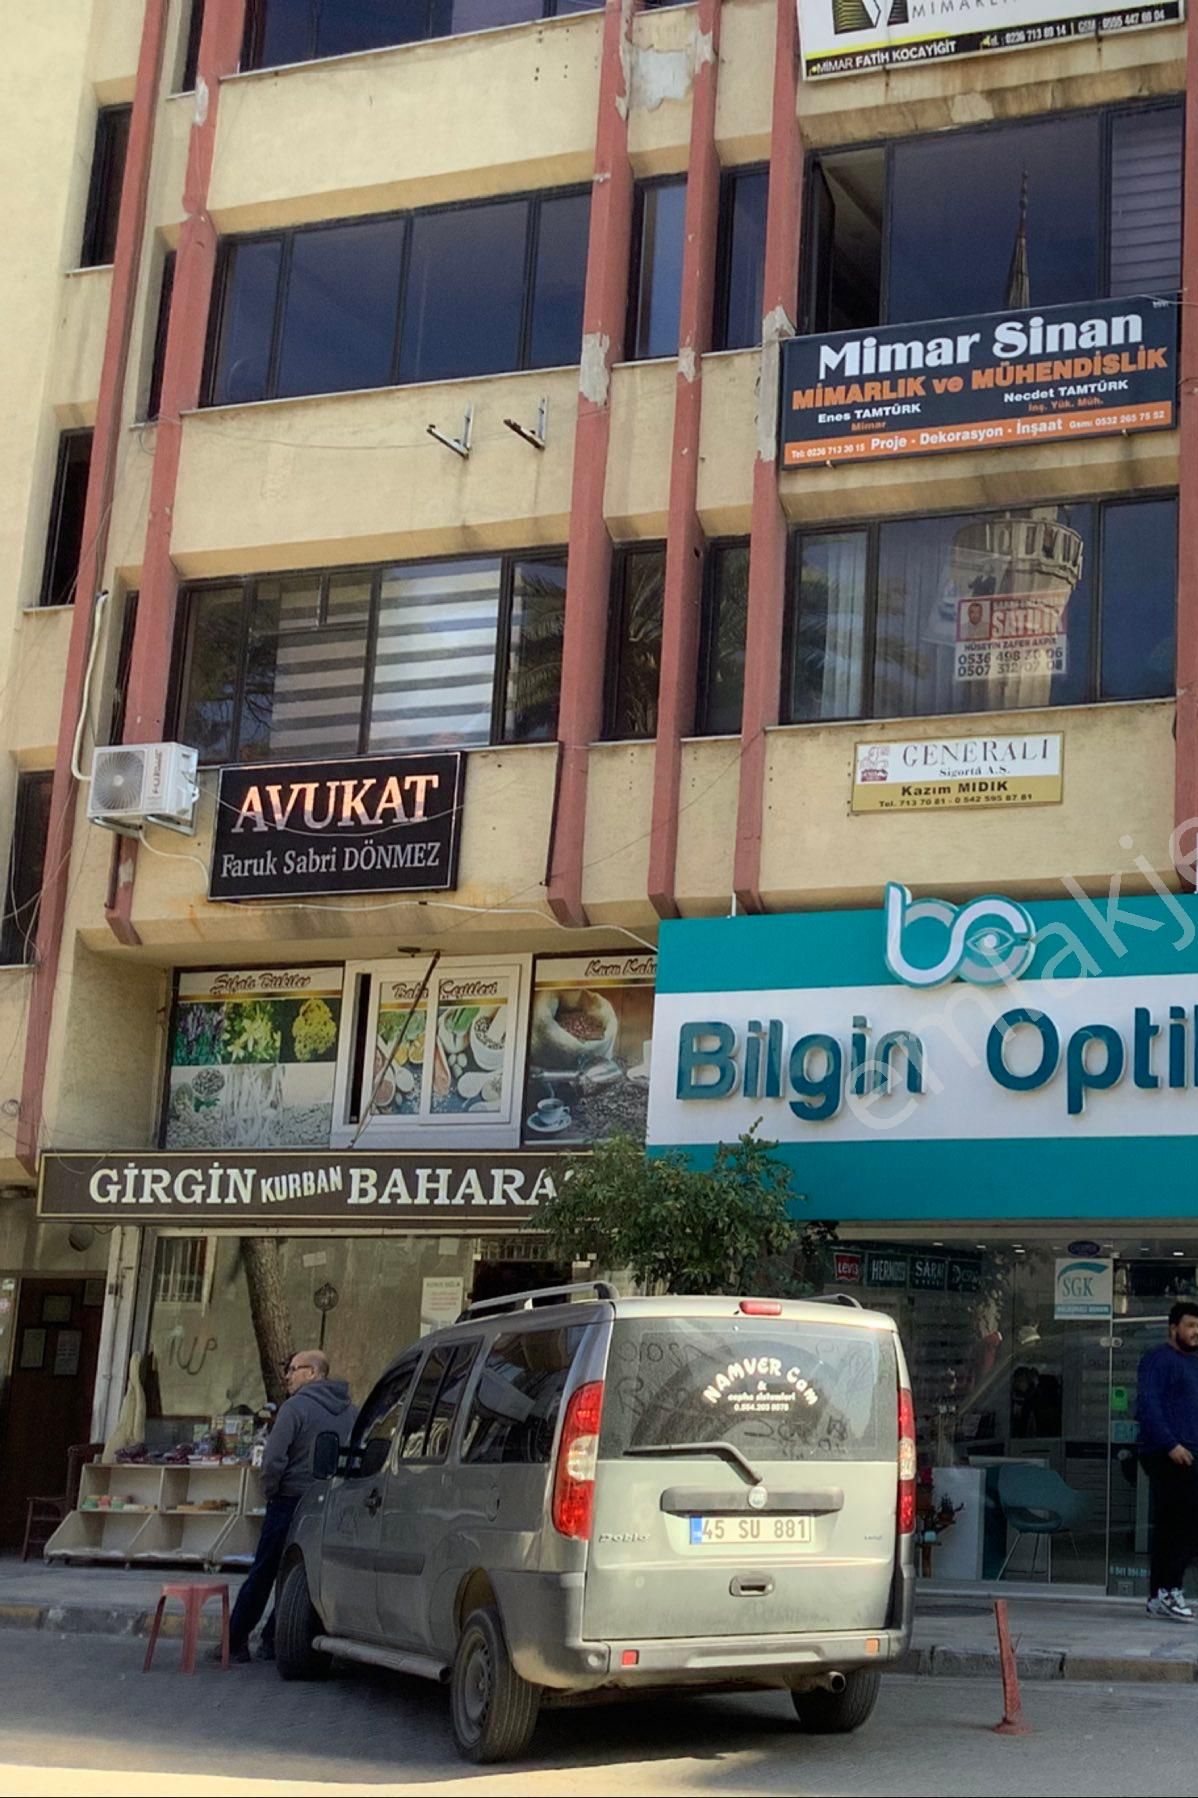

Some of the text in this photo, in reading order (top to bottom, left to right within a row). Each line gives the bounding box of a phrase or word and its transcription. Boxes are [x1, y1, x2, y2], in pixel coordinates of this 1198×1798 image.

[1027, 28, 1042, 40] 713
[1056, 24, 1067, 35] 14
[819, 312, 1143, 380] Mimar Sinan
[792, 345, 1168, 410] MİMARLIK ve MÜHENDİSLİK
[1003, 379, 1129, 403] Necdet TAMTÜRK
[818, 403, 922, 424] Enes TAMTÜRK
[851, 421, 886, 432] Mimar
[870, 418, 1063, 452] Proje Dekorasyon İnşaat
[828, 445, 842, 455] 713
[958, 652, 992, 665] 0536
[958, 664, 991, 678] 0507
[902, 738, 1049, 768] GENERALI
[901, 780, 1008, 796] Kazım MIDIK
[231, 774, 439, 834] AVUKAT
[221, 840, 441, 878] Faruk Sabri DÖNMEZ
[676, 1014, 927, 1121] Bilgin
[89, 1162, 576, 1206] GİRGİN KURBAN BAHARA
[1062, 1276, 1094, 1298] SGK
[757, 1380, 768, 1391] &
[702, 1518, 807, 1540] 45 SU 881
